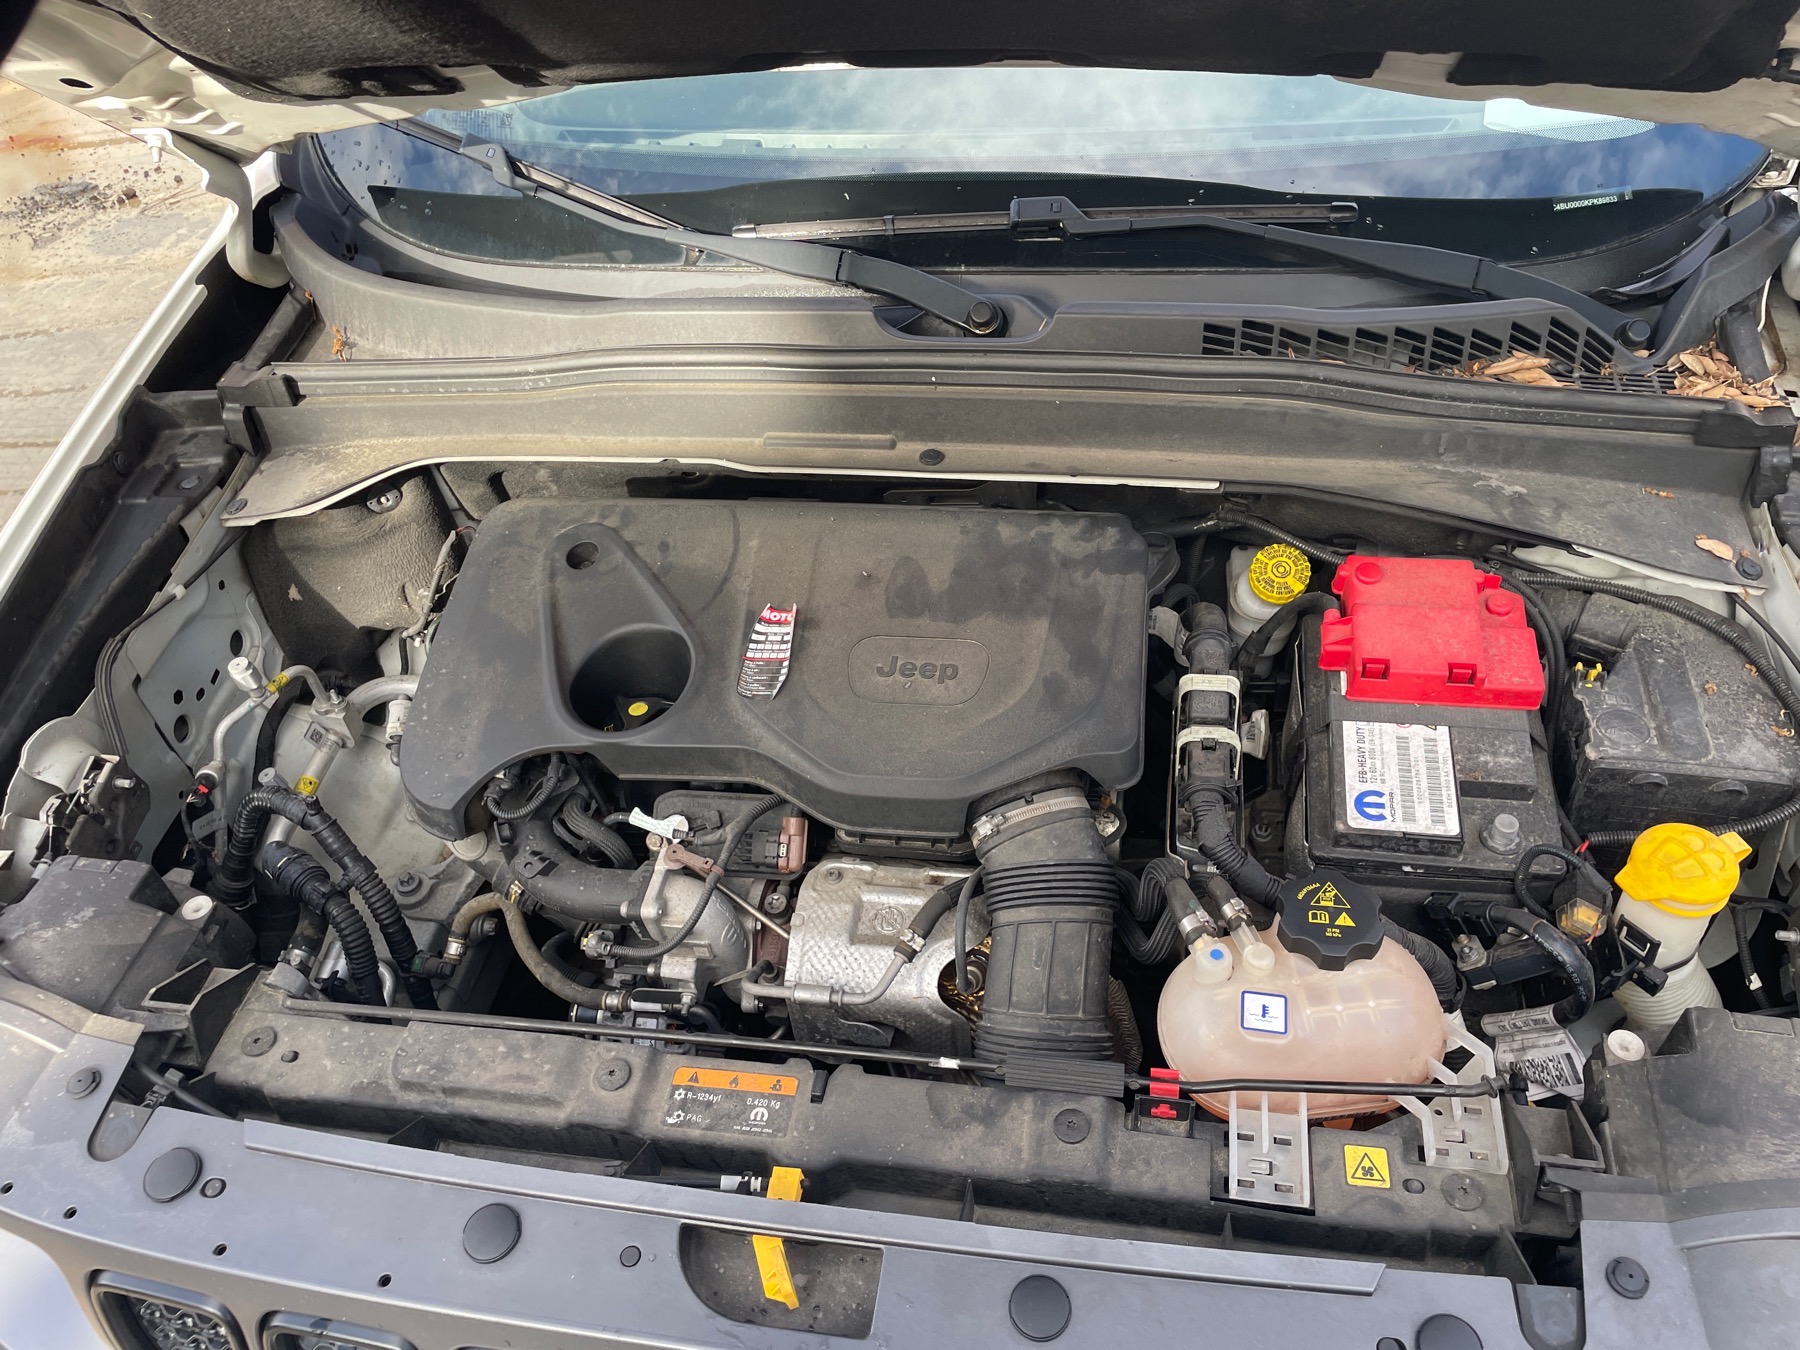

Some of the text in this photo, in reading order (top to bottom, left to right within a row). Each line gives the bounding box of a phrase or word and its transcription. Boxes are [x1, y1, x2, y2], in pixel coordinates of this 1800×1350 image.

[876, 656, 959, 684] Jeep
[1356, 726, 1368, 783] EFB-HEAVY DUTY
[687, 1091, 780, 1109] R-1234yf 0.420 Kg
[686, 1114, 702, 1122] PAG
